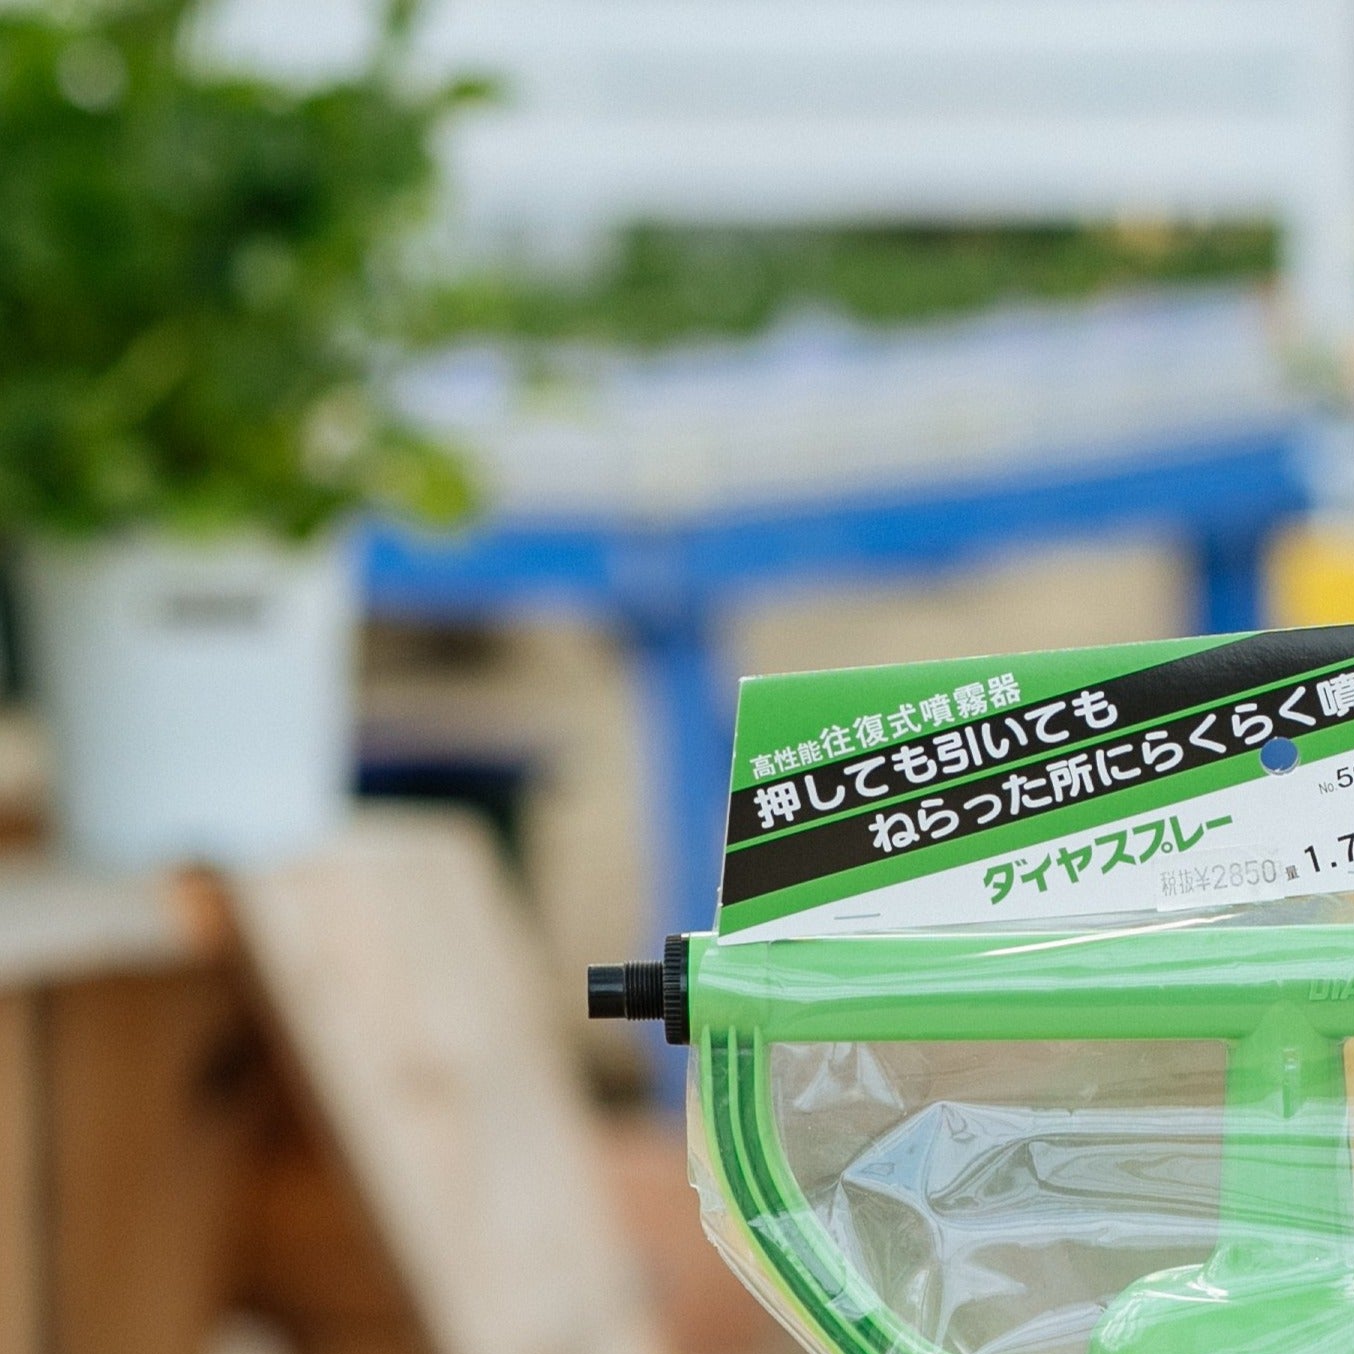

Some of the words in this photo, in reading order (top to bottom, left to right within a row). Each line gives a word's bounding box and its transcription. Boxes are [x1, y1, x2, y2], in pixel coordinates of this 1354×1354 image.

[749, 673, 1022, 780] 高性能往復式噴霧器
[753, 690, 1119, 829] 押しても引いても
[983, 814, 1234, 905] ダイヤスプレー
